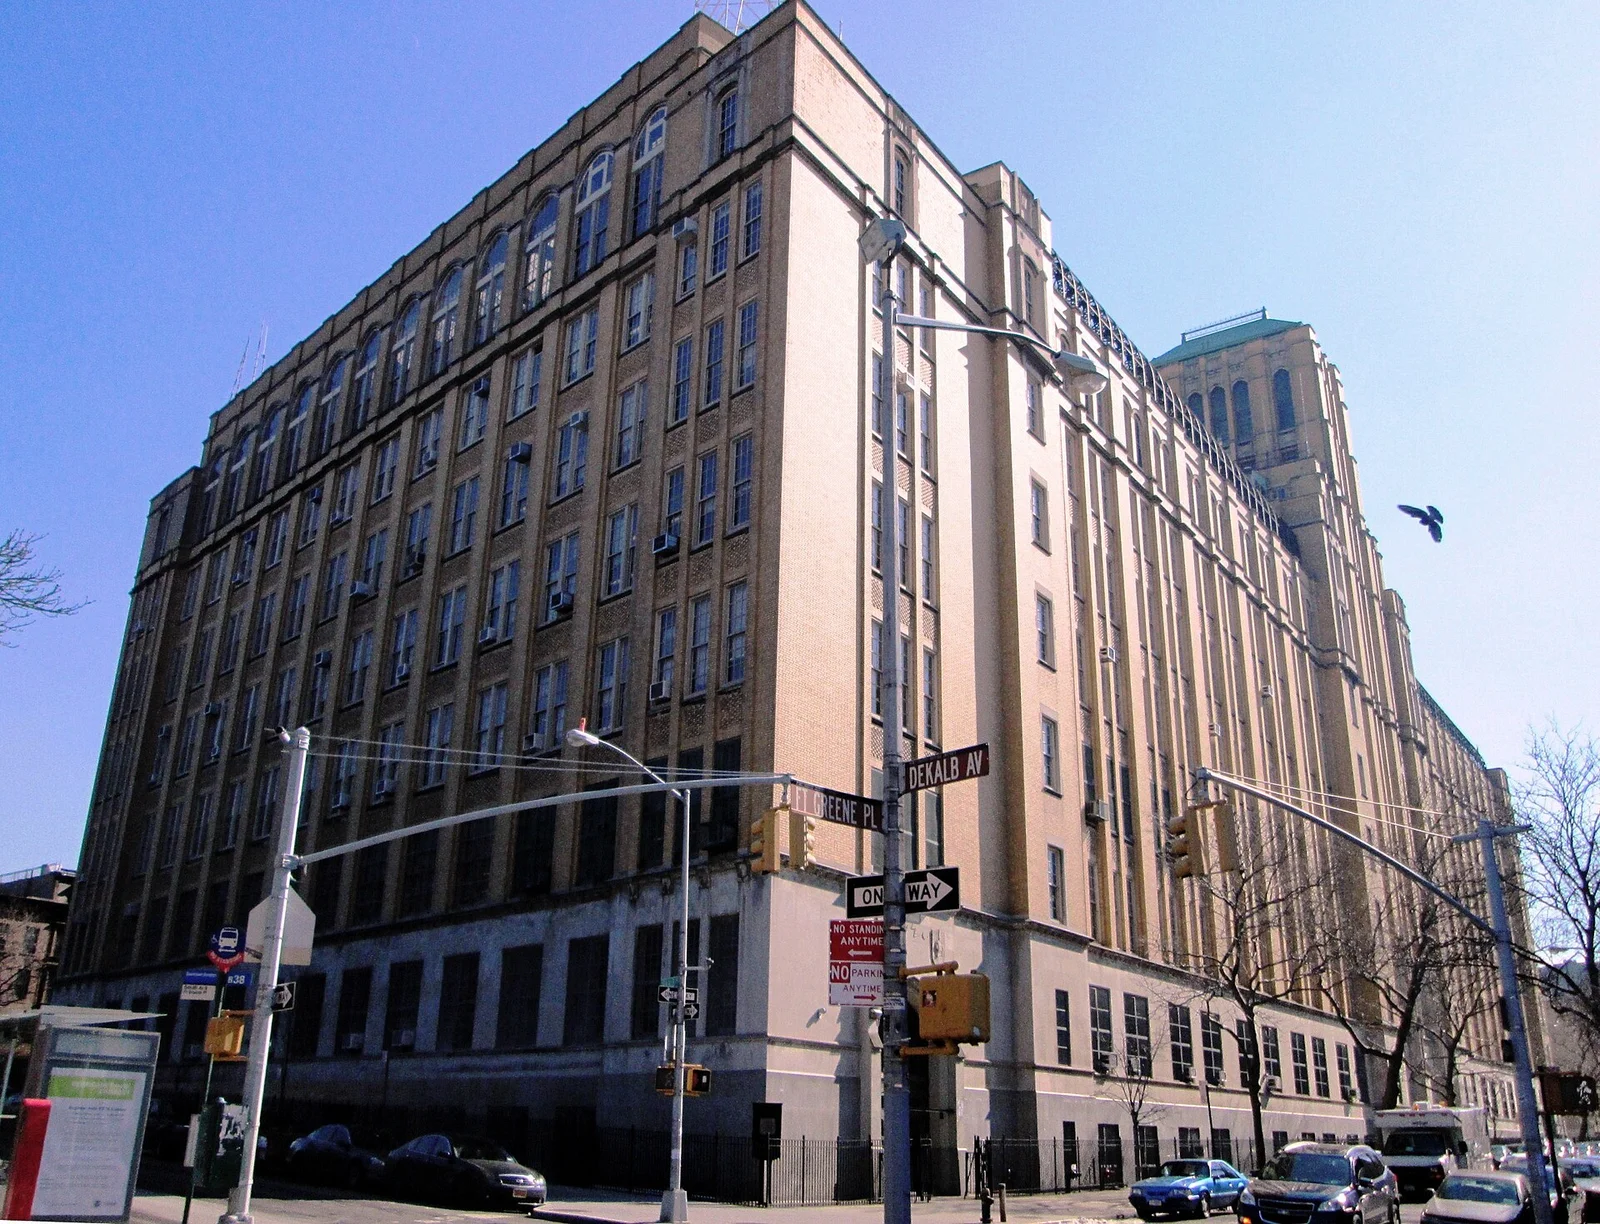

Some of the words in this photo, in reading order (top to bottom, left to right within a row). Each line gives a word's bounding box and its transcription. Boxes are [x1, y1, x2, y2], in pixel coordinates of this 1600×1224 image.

[909, 755, 959, 790] DEKALB
[966, 750, 983, 776] AV
[795, 788, 808, 812] FT
[813, 789, 857, 826] GREENE
[863, 803, 878, 829] PL
[862, 888, 883, 905] ON
[908, 882, 941, 901] WAY
[833, 924, 846, 934] NO
[849, 924, 884, 934] STANDIN
[840, 936, 884, 946] ANYTIME
[227, 974, 246, 985] B38
[831, 964, 849, 981] NO
[851, 968, 884, 978] PARKIN
[843, 985, 881, 993] ANYTIME
